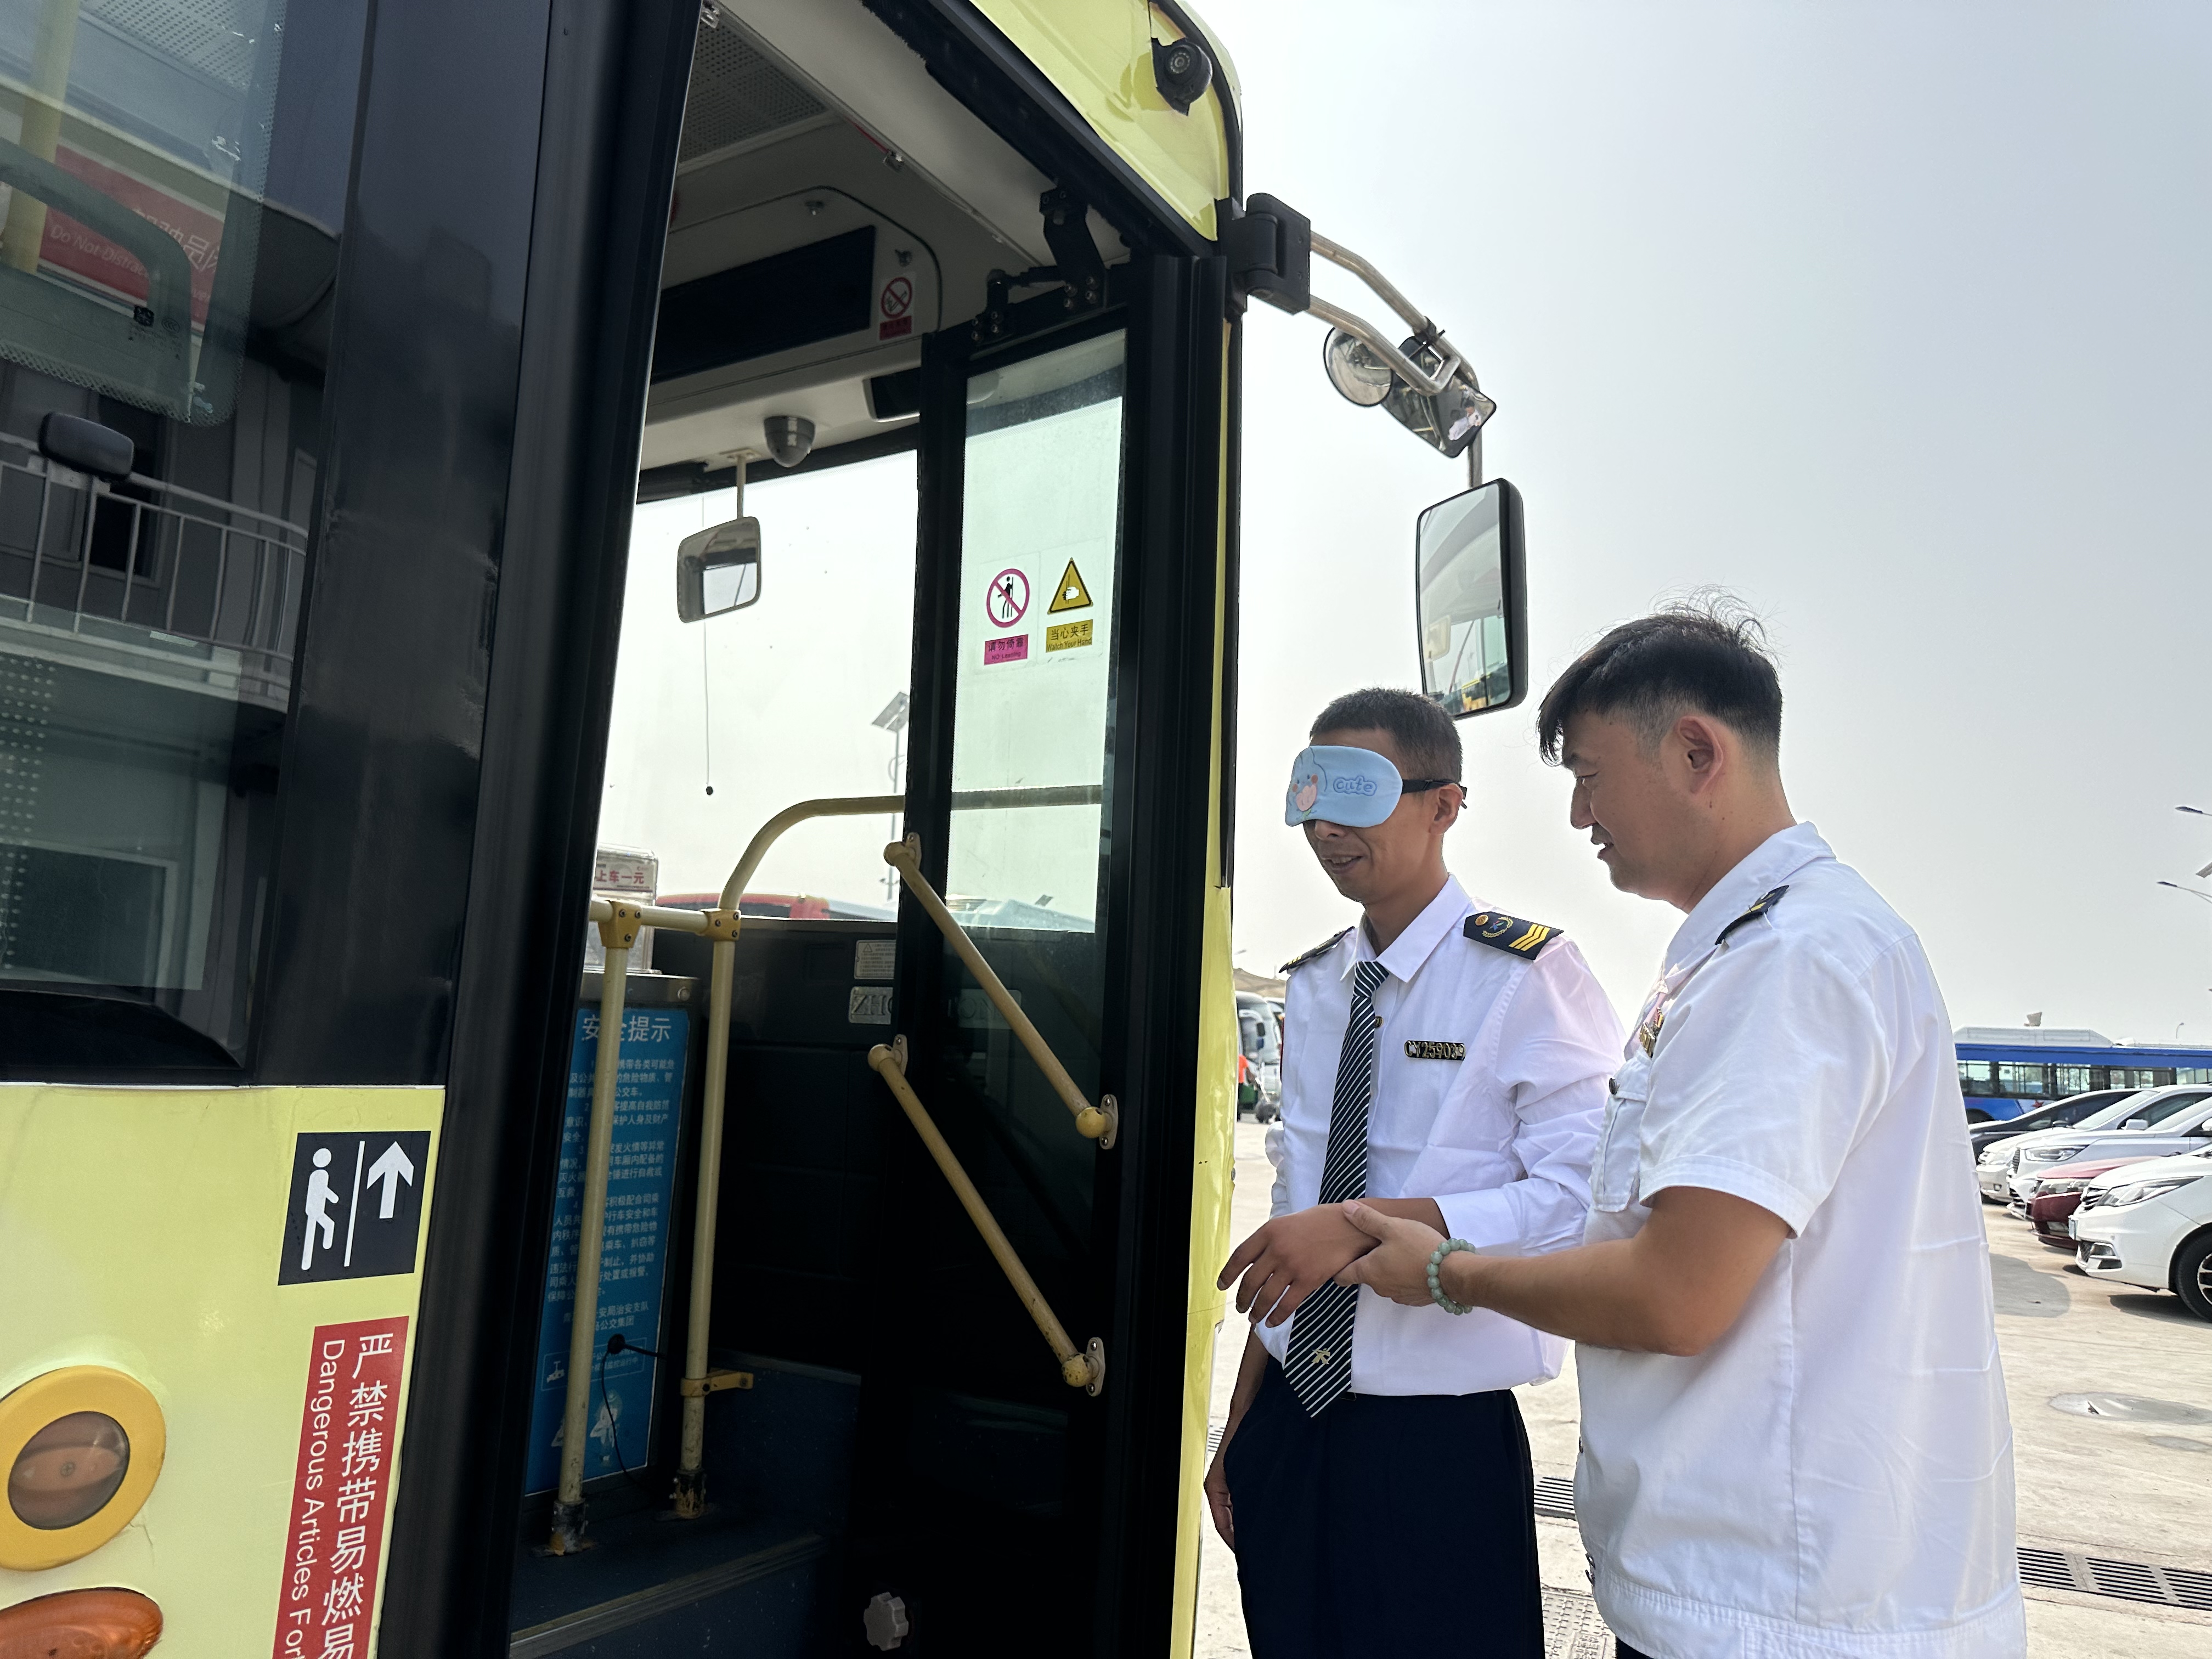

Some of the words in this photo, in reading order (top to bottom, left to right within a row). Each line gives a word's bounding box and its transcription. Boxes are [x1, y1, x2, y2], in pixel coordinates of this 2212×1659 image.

[50, 224, 71, 242] Do
[73, 235, 100, 256] Not
[1051, 623, 1089, 641] 当心夹手
[989, 637, 1024, 652] 请勿倚靠
[1047, 642, 1063, 651] Watch
[1335, 777, 1374, 793] cute
[596, 869, 645, 884] 上车一元
[1404, 1041, 1466, 1060] CY259039
[305, 1339, 346, 1491] Dangerous
[317, 1333, 393, 1659] 严禁携带易燃易
[291, 1498, 325, 1601] Articles
[285, 1608, 311, 1659] For
